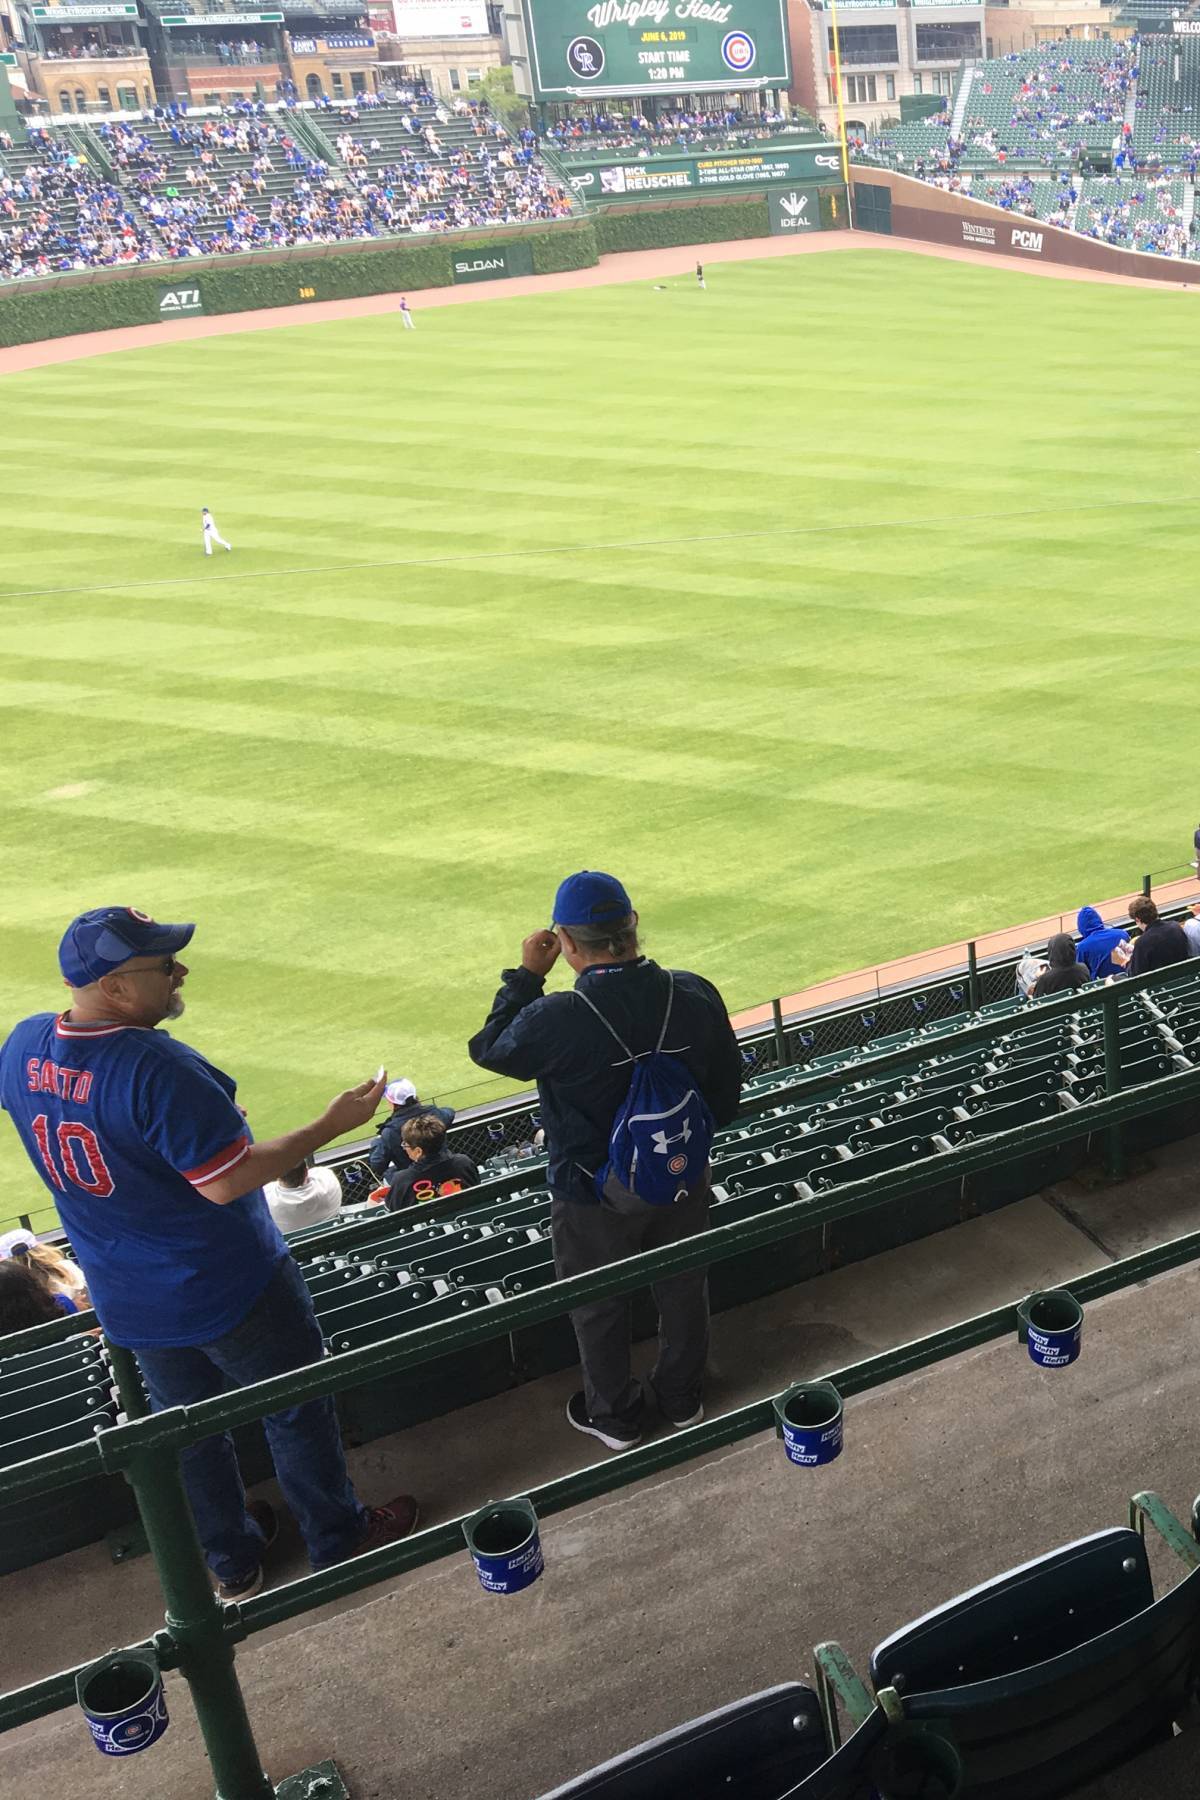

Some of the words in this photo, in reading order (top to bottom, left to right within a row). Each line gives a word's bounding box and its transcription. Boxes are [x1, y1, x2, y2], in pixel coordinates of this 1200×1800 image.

[587, 0, 669, 28] Wrigley
[675, 0, 733, 23] Field
[641, 31, 659, 42] JUNE
[669, 31, 686, 41] 2019
[638, 51, 665, 65] START
[666, 50, 690, 63] TIME
[647, 67, 668, 80] 1:20
[669, 67, 684, 79] PM
[624, 166, 646, 176] RICK
[626, 174, 692, 190] REUSCHEL
[780, 217, 811, 227] IDEAL
[962, 222, 996, 236] WINTRUST
[1011, 229, 1044, 249] PCM
[455, 258, 504, 273] SLOAN
[160, 289, 199, 307] ATI
[27, 1058, 94, 1104] SATO
[32, 1114, 116, 1197] 10
[1034, 1343, 1060, 1356] Hefty
[791, 1452, 818, 1463] Hefty
